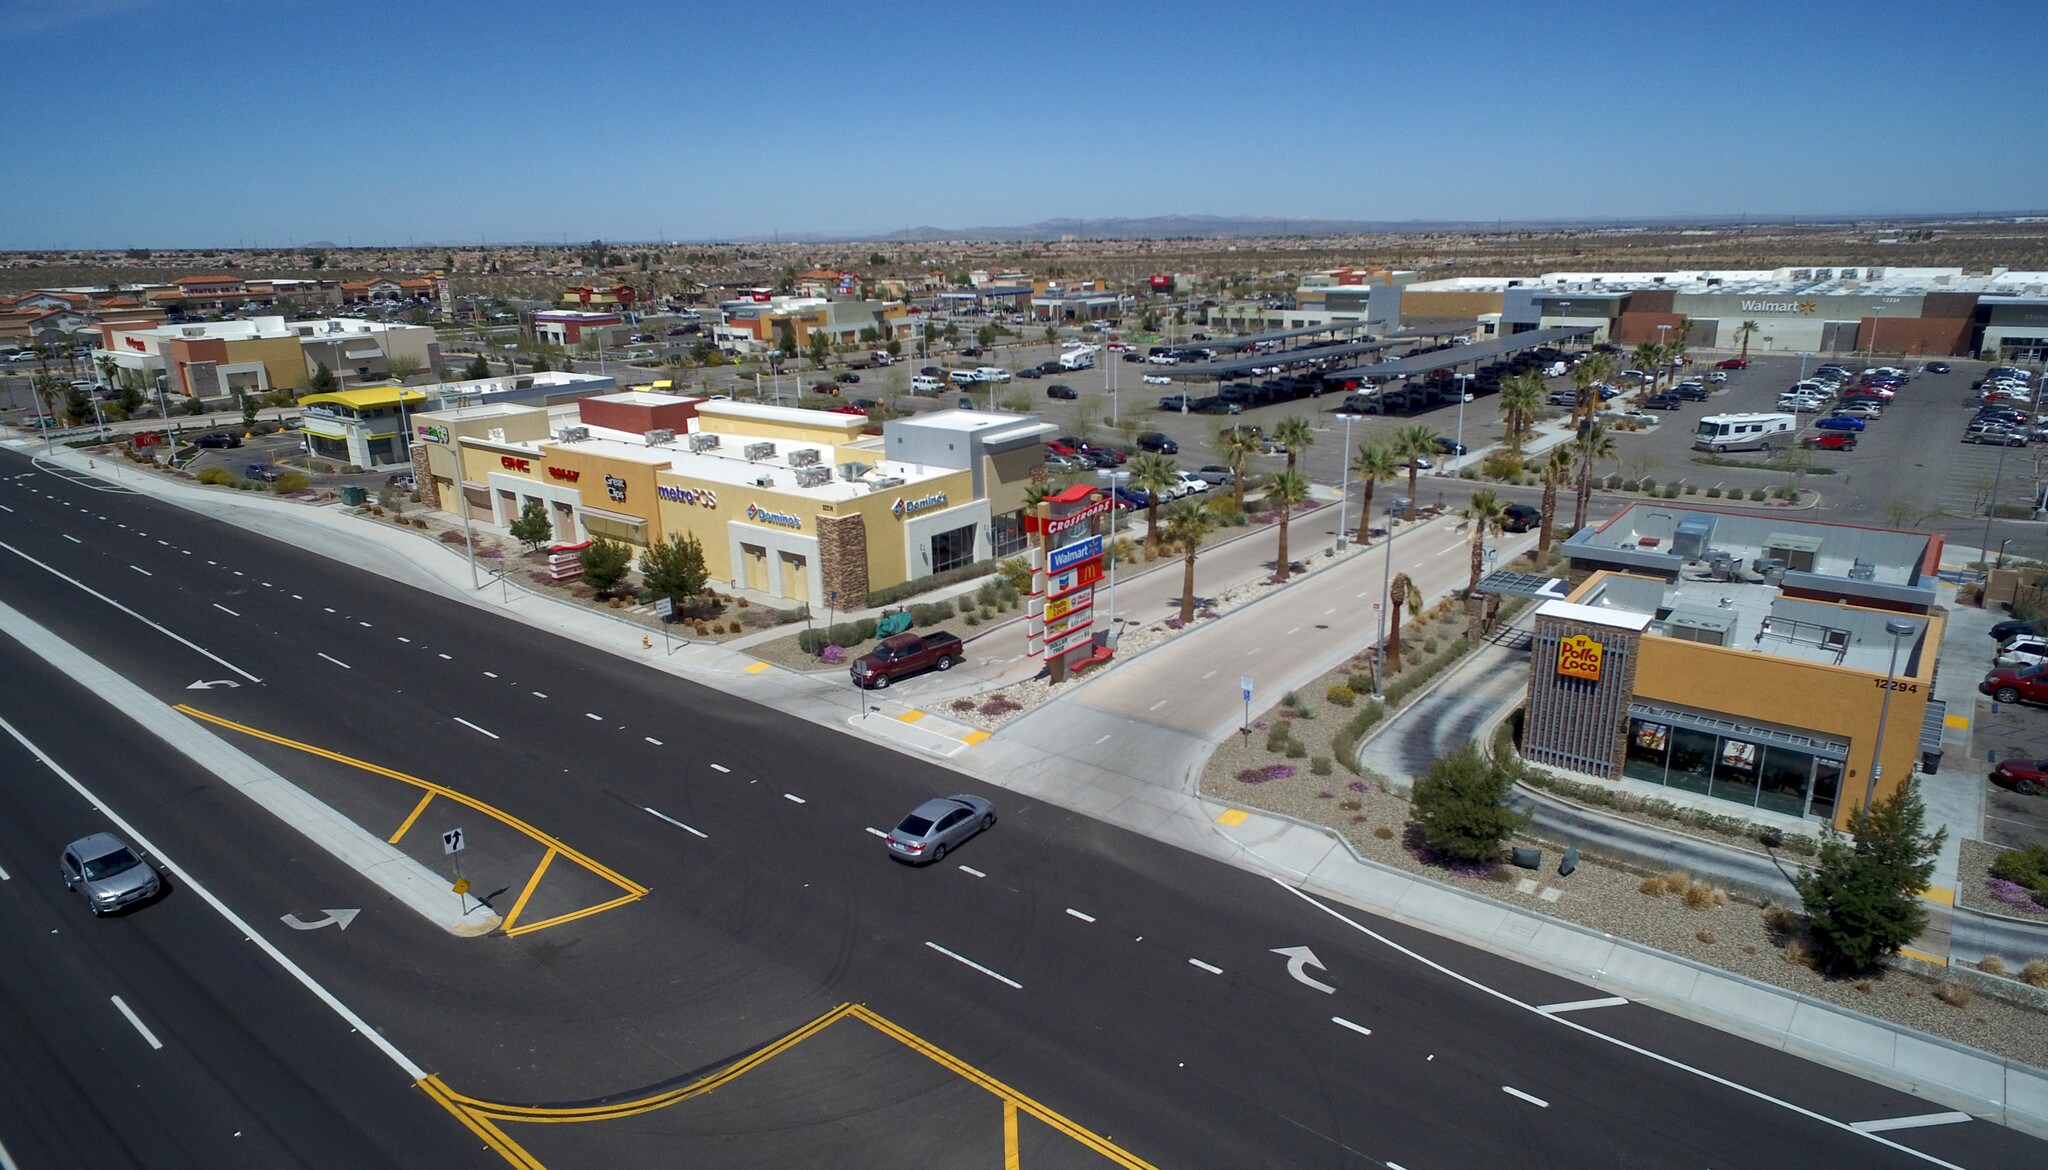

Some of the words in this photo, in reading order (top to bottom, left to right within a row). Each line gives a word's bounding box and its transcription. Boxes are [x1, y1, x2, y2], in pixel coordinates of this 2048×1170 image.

[1741, 300, 1799, 312] Walmart
[501, 456, 531, 473] GNC
[604, 474, 625, 488] Great
[608, 487, 625, 500] Clips
[658, 485, 717, 507] metroPCS
[905, 491, 948, 512] Domino's
[757, 507, 801, 526] Domino's
[1048, 500, 1110, 534] CROSSROADS
[1054, 545, 1088, 566] Walmart
[1561, 641, 1598, 662] Pollo
[1562, 656, 1598, 672] Loco
[1874, 679, 1918, 693] 12294
